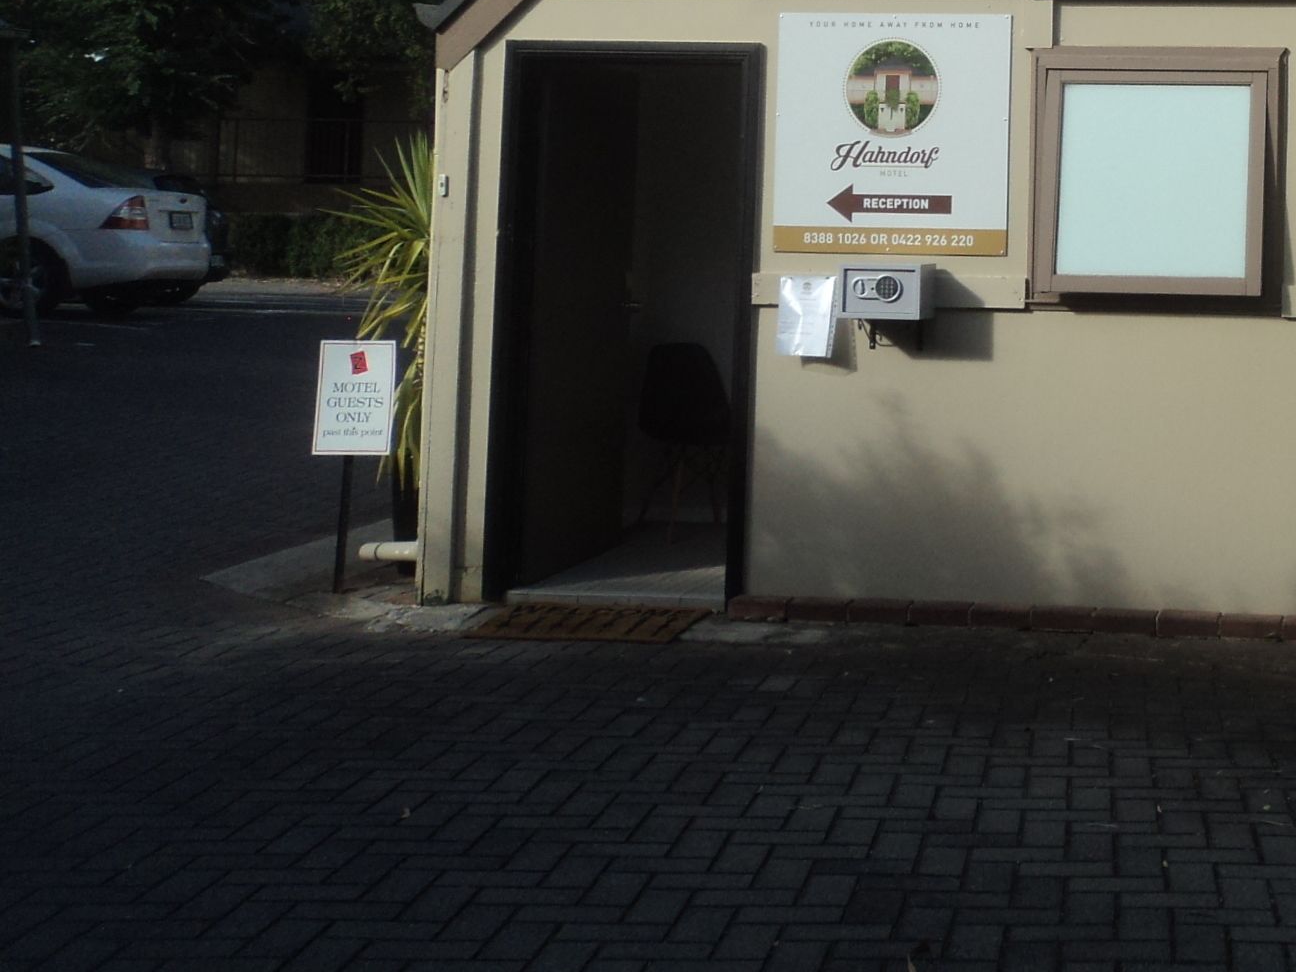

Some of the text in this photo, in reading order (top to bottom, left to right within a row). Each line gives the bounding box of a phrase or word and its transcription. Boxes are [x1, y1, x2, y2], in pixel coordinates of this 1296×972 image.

[914, 21, 944, 29] FROM
[950, 21, 981, 29] HOME
[830, 140, 940, 171] Hahndorf
[863, 198, 929, 210] RECEPTION
[803, 232, 974, 247] 8388 1026 OR 0422 926 220
[332, 382, 381, 393] MOTEL
[326, 397, 384, 408] GUESTS
[336, 411, 372, 423] ONLY
[322, 428, 383, 438] past this point
